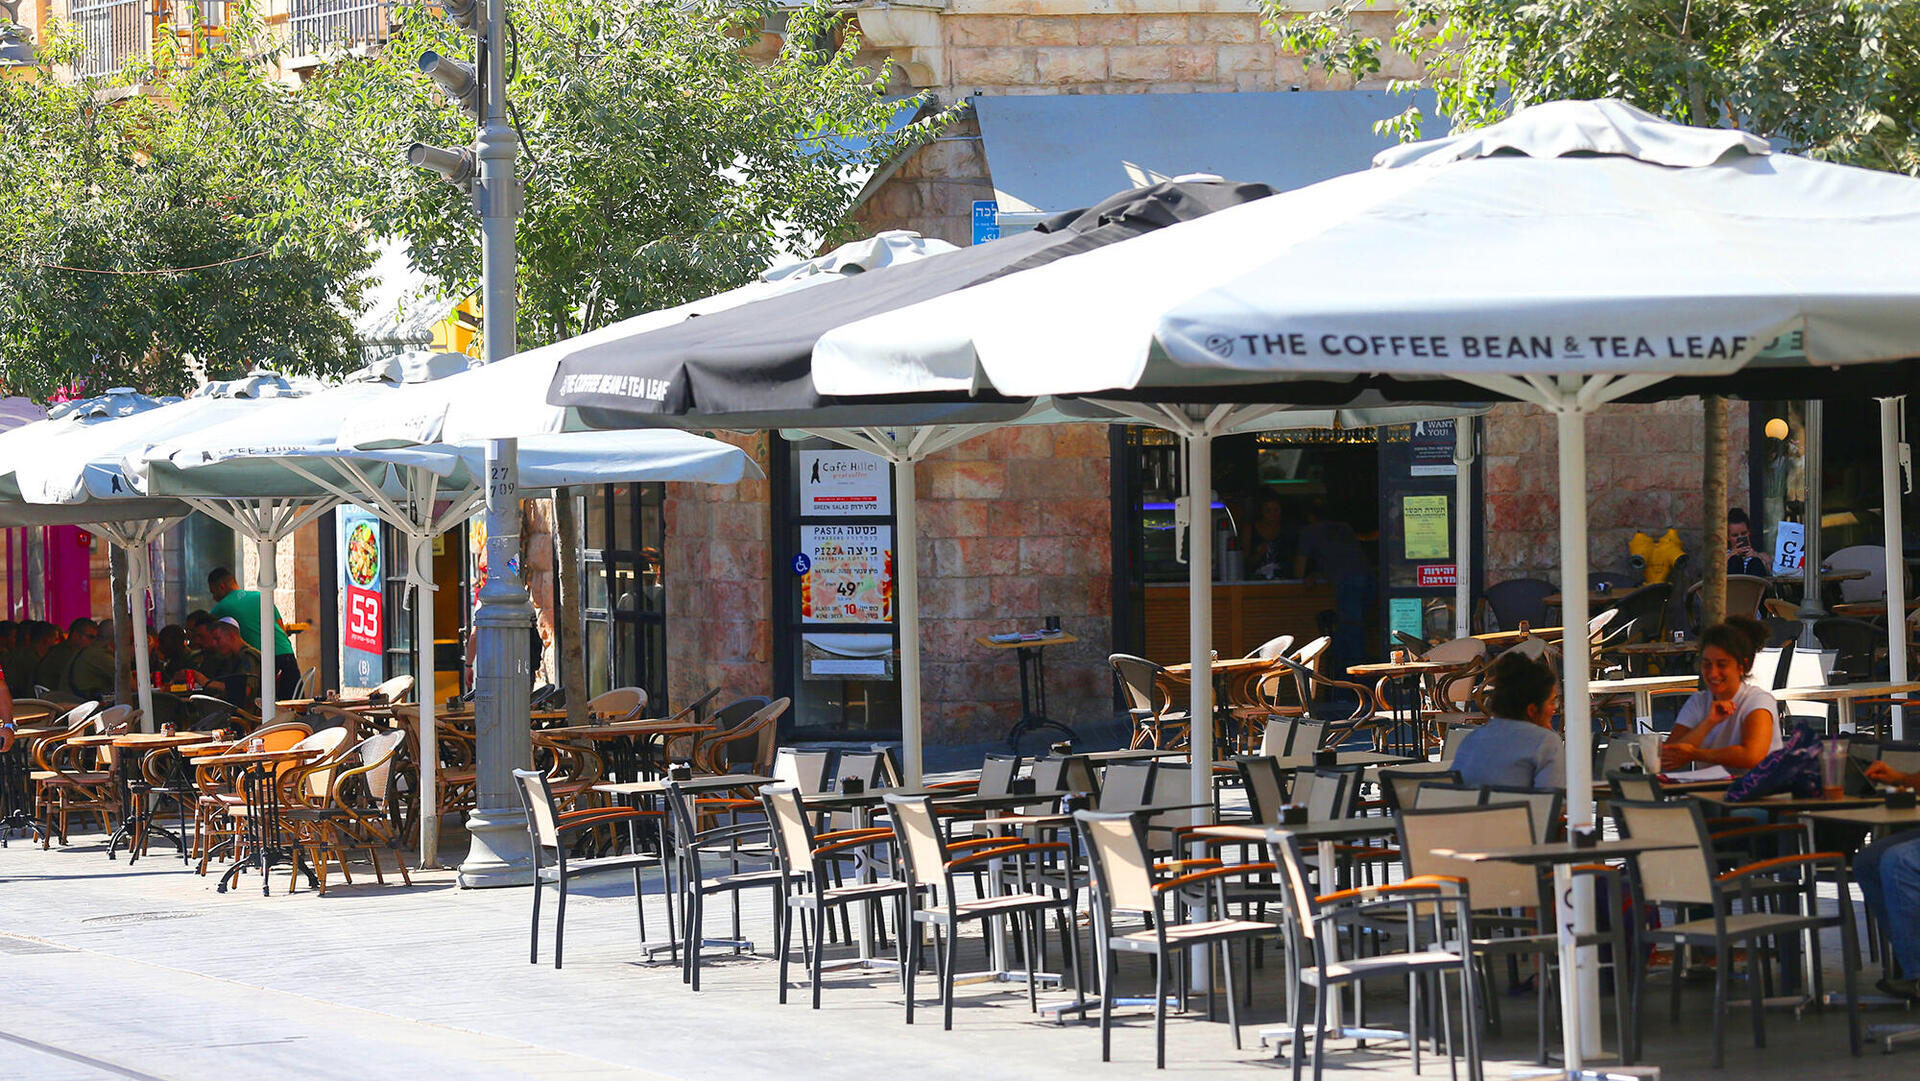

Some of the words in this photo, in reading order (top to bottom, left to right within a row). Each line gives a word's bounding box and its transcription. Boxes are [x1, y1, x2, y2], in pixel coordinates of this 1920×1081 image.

[1241, 334, 1307, 355] THE
[1320, 334, 1448, 357] COFFEE
[1461, 336, 1553, 359] BEAN
[1564, 335, 1585, 359] &
[1589, 336, 1655, 359] TEA
[1668, 336, 1747, 360] LEAF
[627, 375, 645, 398] TEA
[645, 378, 671, 401] LEAF
[1427, 420, 1454, 429] WANT
[1427, 429, 1449, 437] YOU!
[822, 461, 847, 472] Café
[850, 462, 878, 471] Hillel
[491, 467, 509, 480] 27
[490, 482, 515, 498] 709
[814, 527, 843, 535] PASTA
[847, 526, 877, 535] פסטה
[814, 546, 844, 556] PIZZA
[847, 546, 878, 556] פיצה
[1423, 567, 1455, 575] זהירות
[1422, 575, 1456, 585] מדרגה!
[837, 581, 856, 596] 49
[844, 603, 857, 614] 10
[351, 593, 378, 637] 53
[358, 660, 370, 676] (B)
